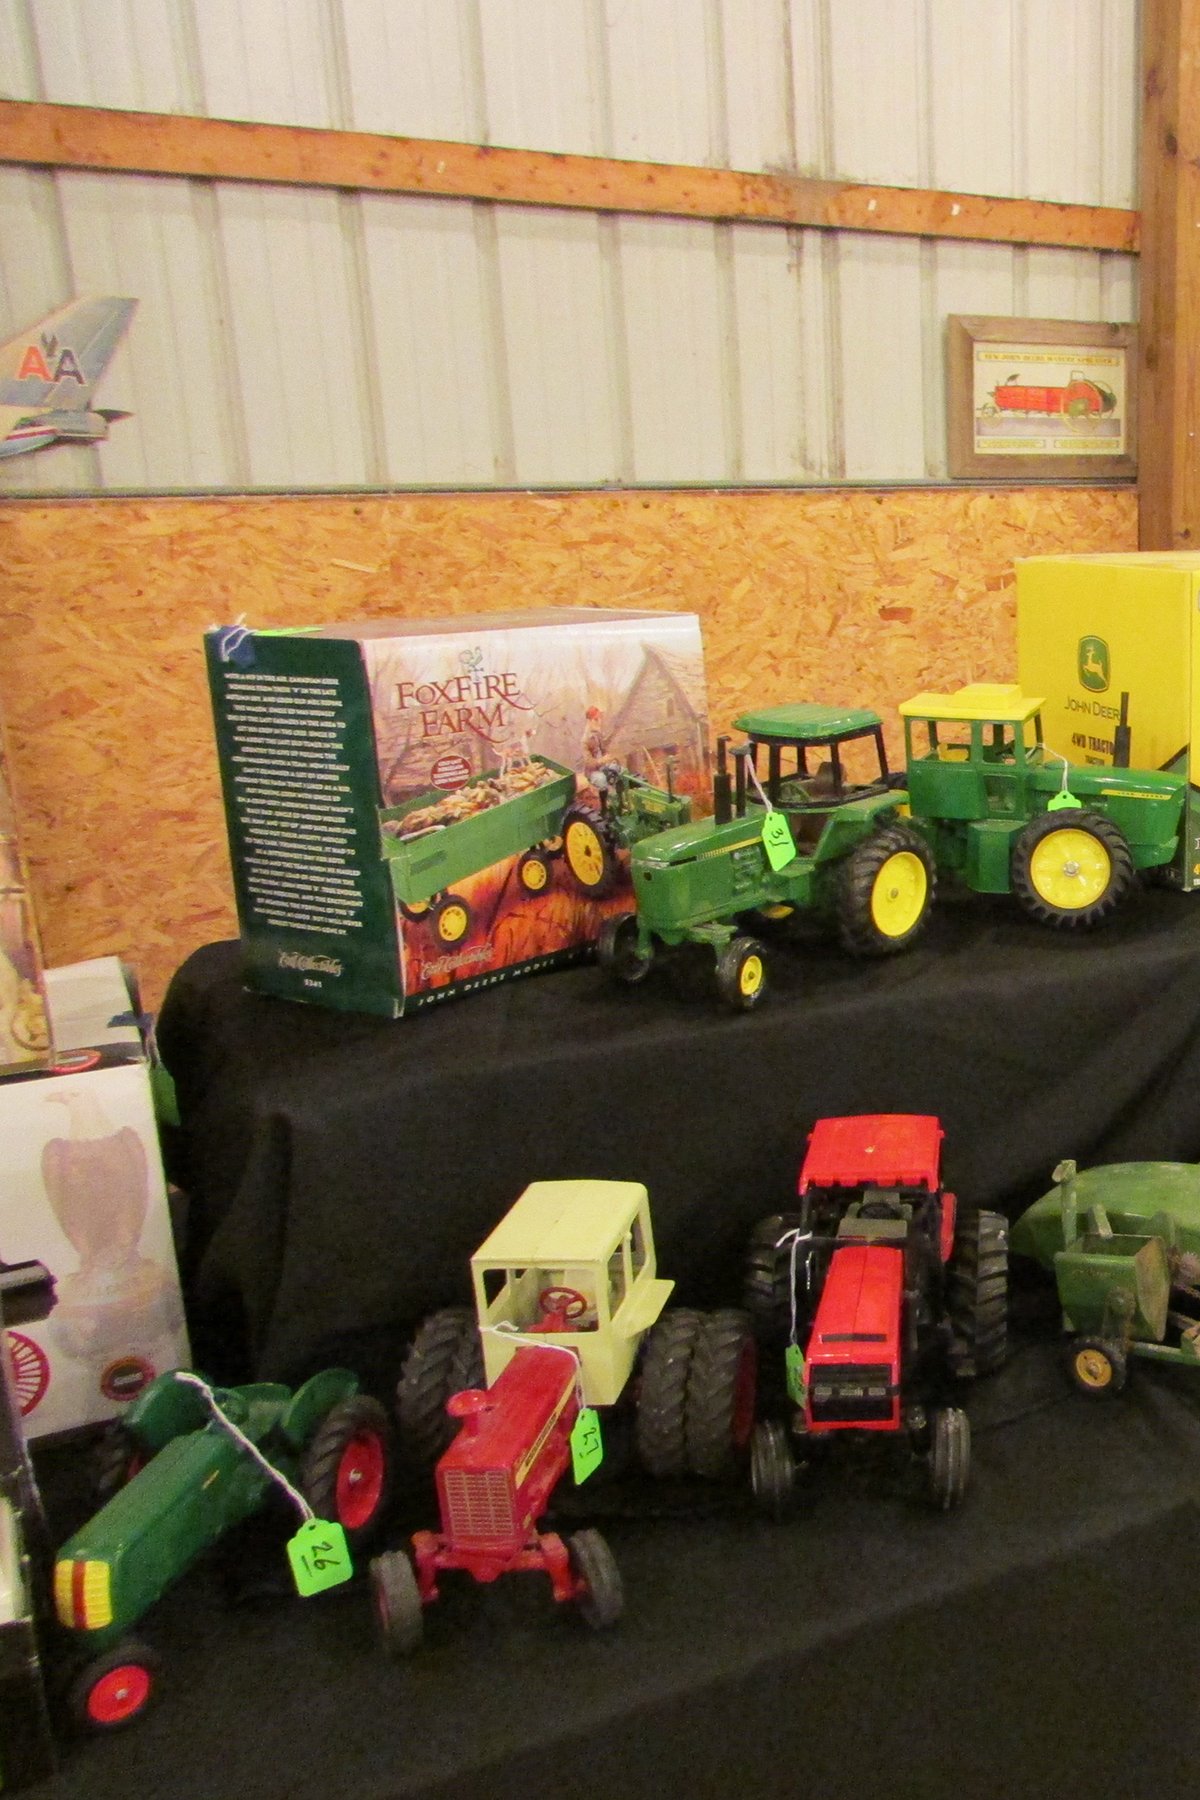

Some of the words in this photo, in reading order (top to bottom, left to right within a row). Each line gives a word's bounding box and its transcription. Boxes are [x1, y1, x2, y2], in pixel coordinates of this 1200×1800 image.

[1064, 696, 1091, 714] JOHN
[1093, 701, 1120, 721] DEER
[420, 703, 511, 743] FARM
[418, 989, 455, 1006] JOHN
[312, 1541, 340, 1570] 26
